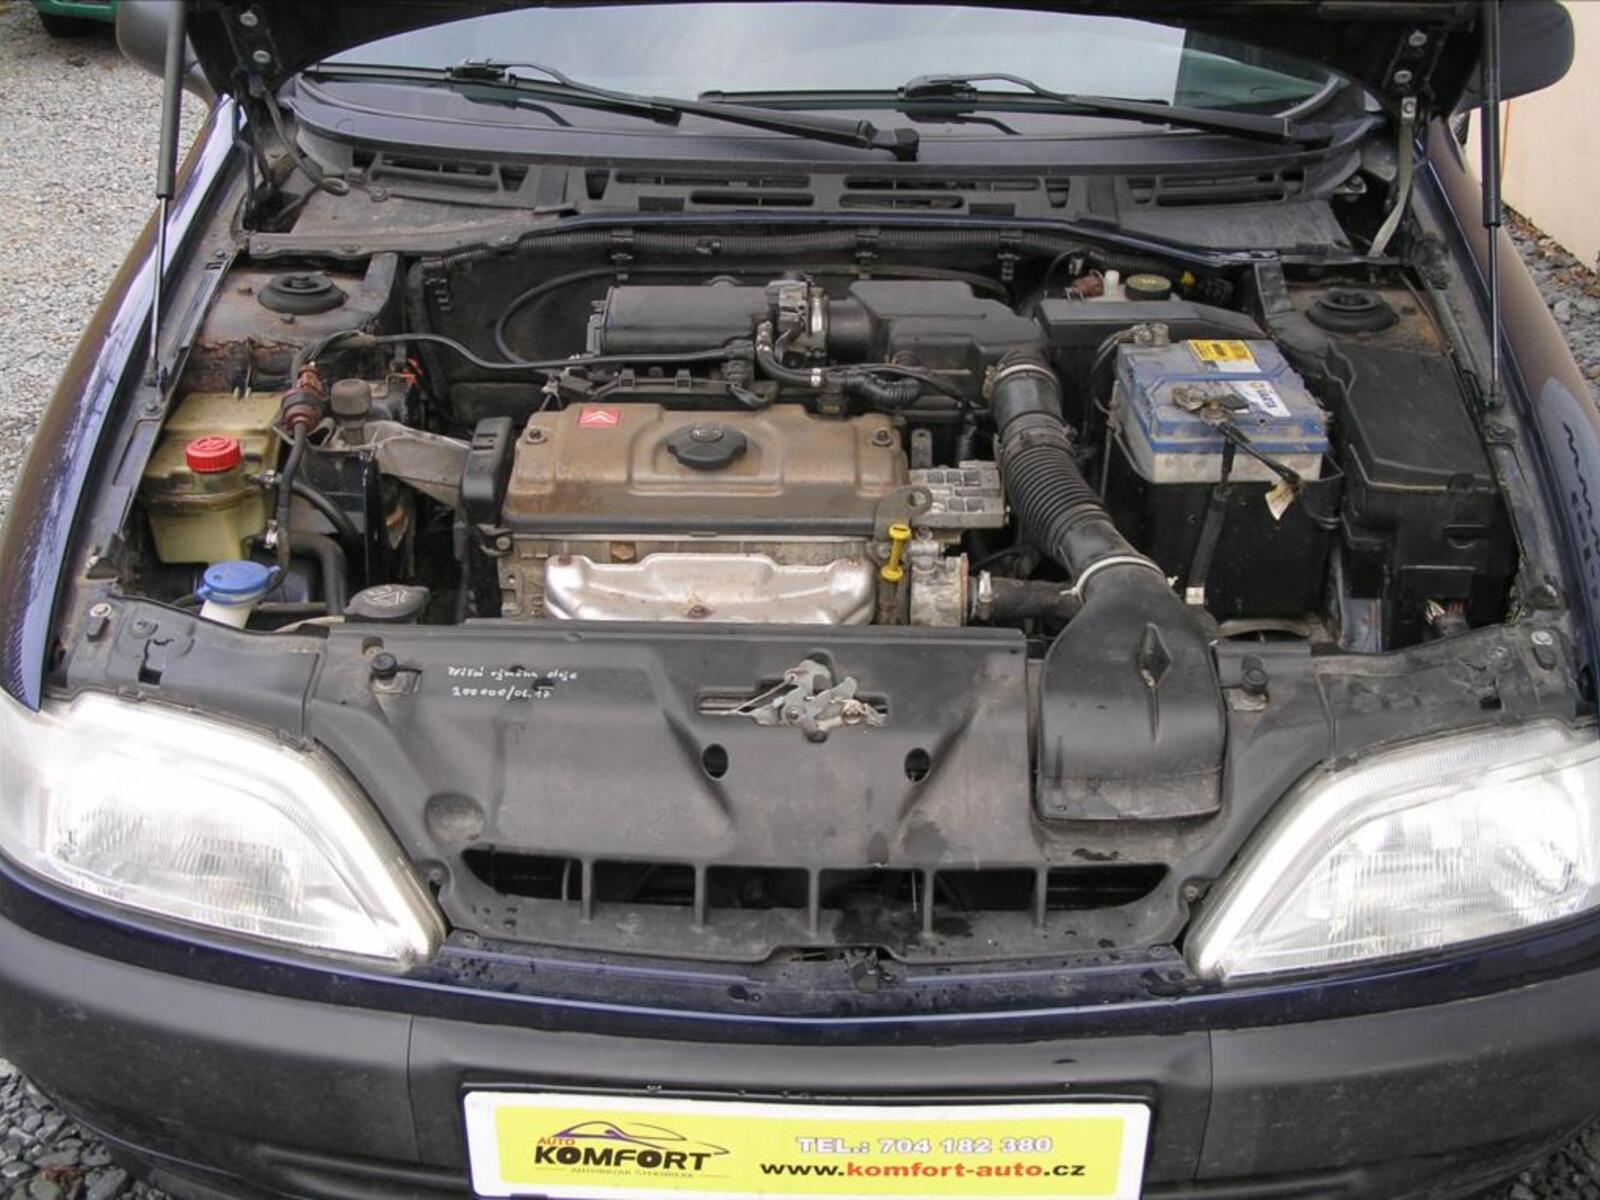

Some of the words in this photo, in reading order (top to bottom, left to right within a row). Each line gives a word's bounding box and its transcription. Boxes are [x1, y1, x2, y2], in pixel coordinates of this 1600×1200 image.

[537, 1137, 576, 1146] AUTO
[878, 1136, 931, 1153] 704
[942, 1137, 993, 1154] 182
[999, 1136, 1053, 1153] 380
[534, 1146, 712, 1171] KOMFORT
[760, 1161, 1086, 1178] www.komfort-auto.cz
